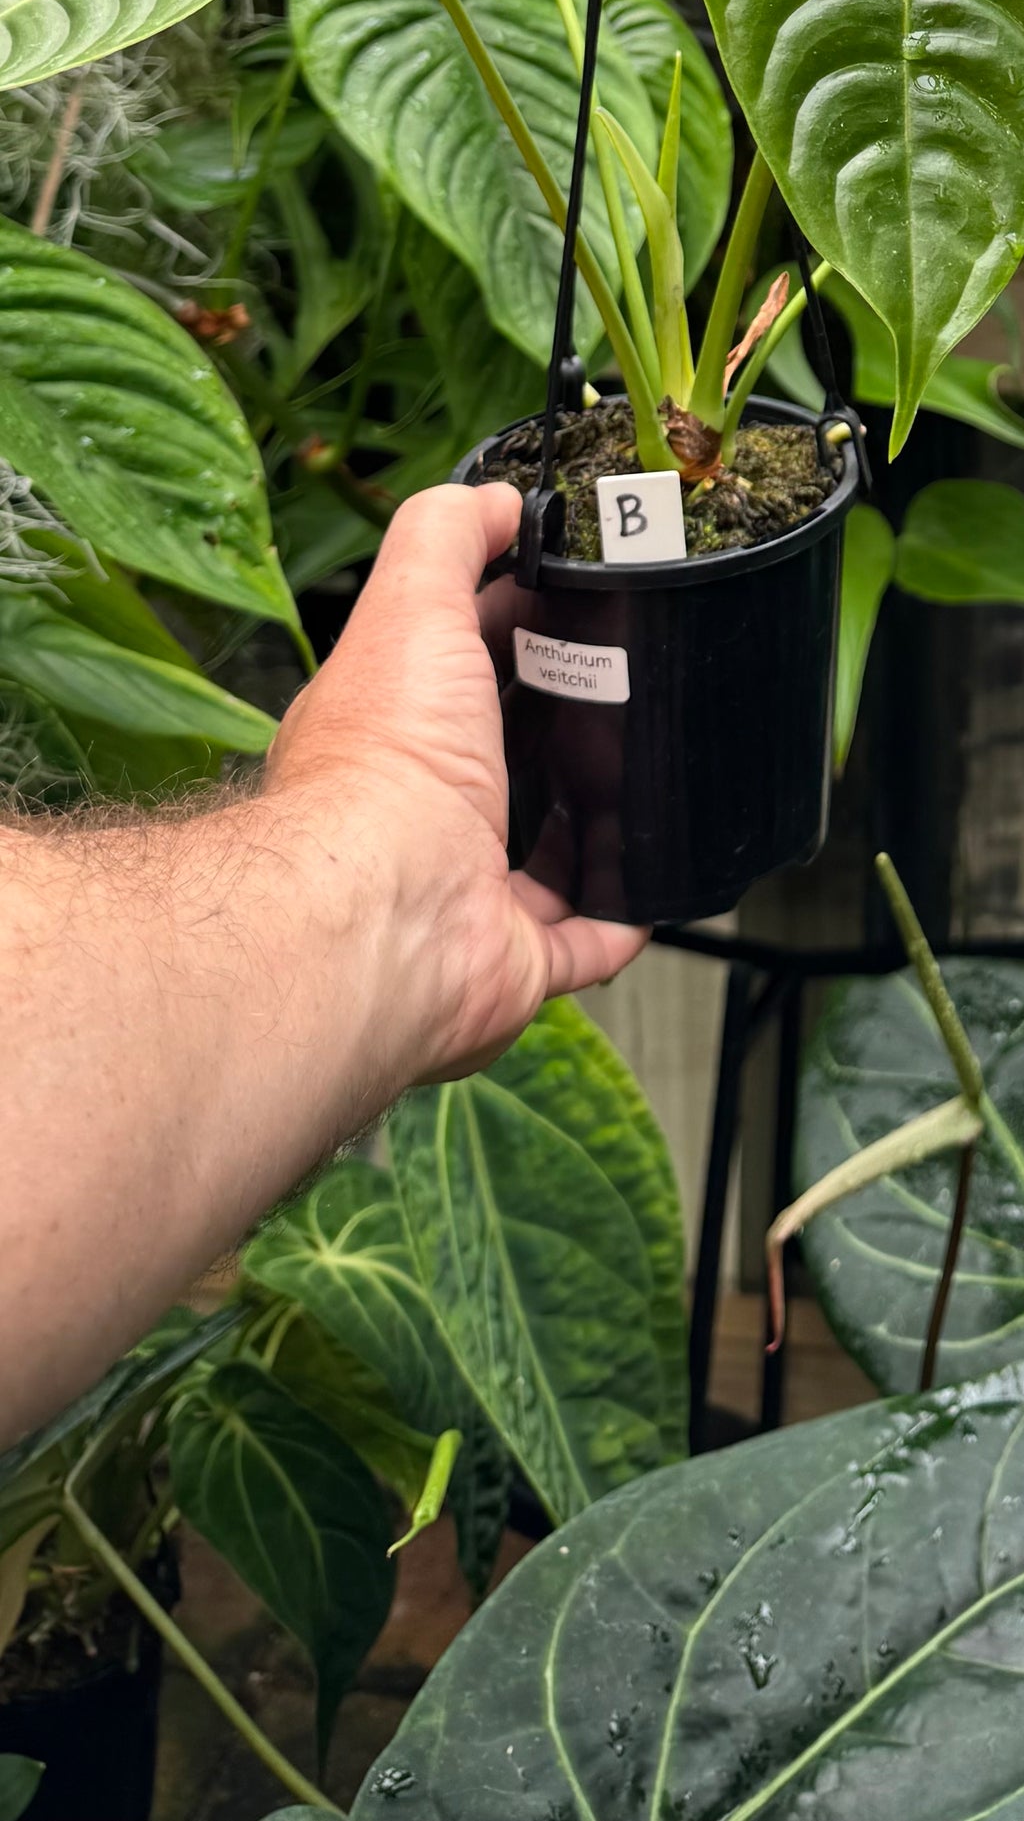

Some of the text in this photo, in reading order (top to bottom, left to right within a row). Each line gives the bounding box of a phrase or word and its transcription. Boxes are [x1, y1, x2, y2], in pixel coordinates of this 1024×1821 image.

[616, 493, 648, 537] B
[525, 638, 612, 668] Anthurium
[539, 667, 597, 689] veitchii
